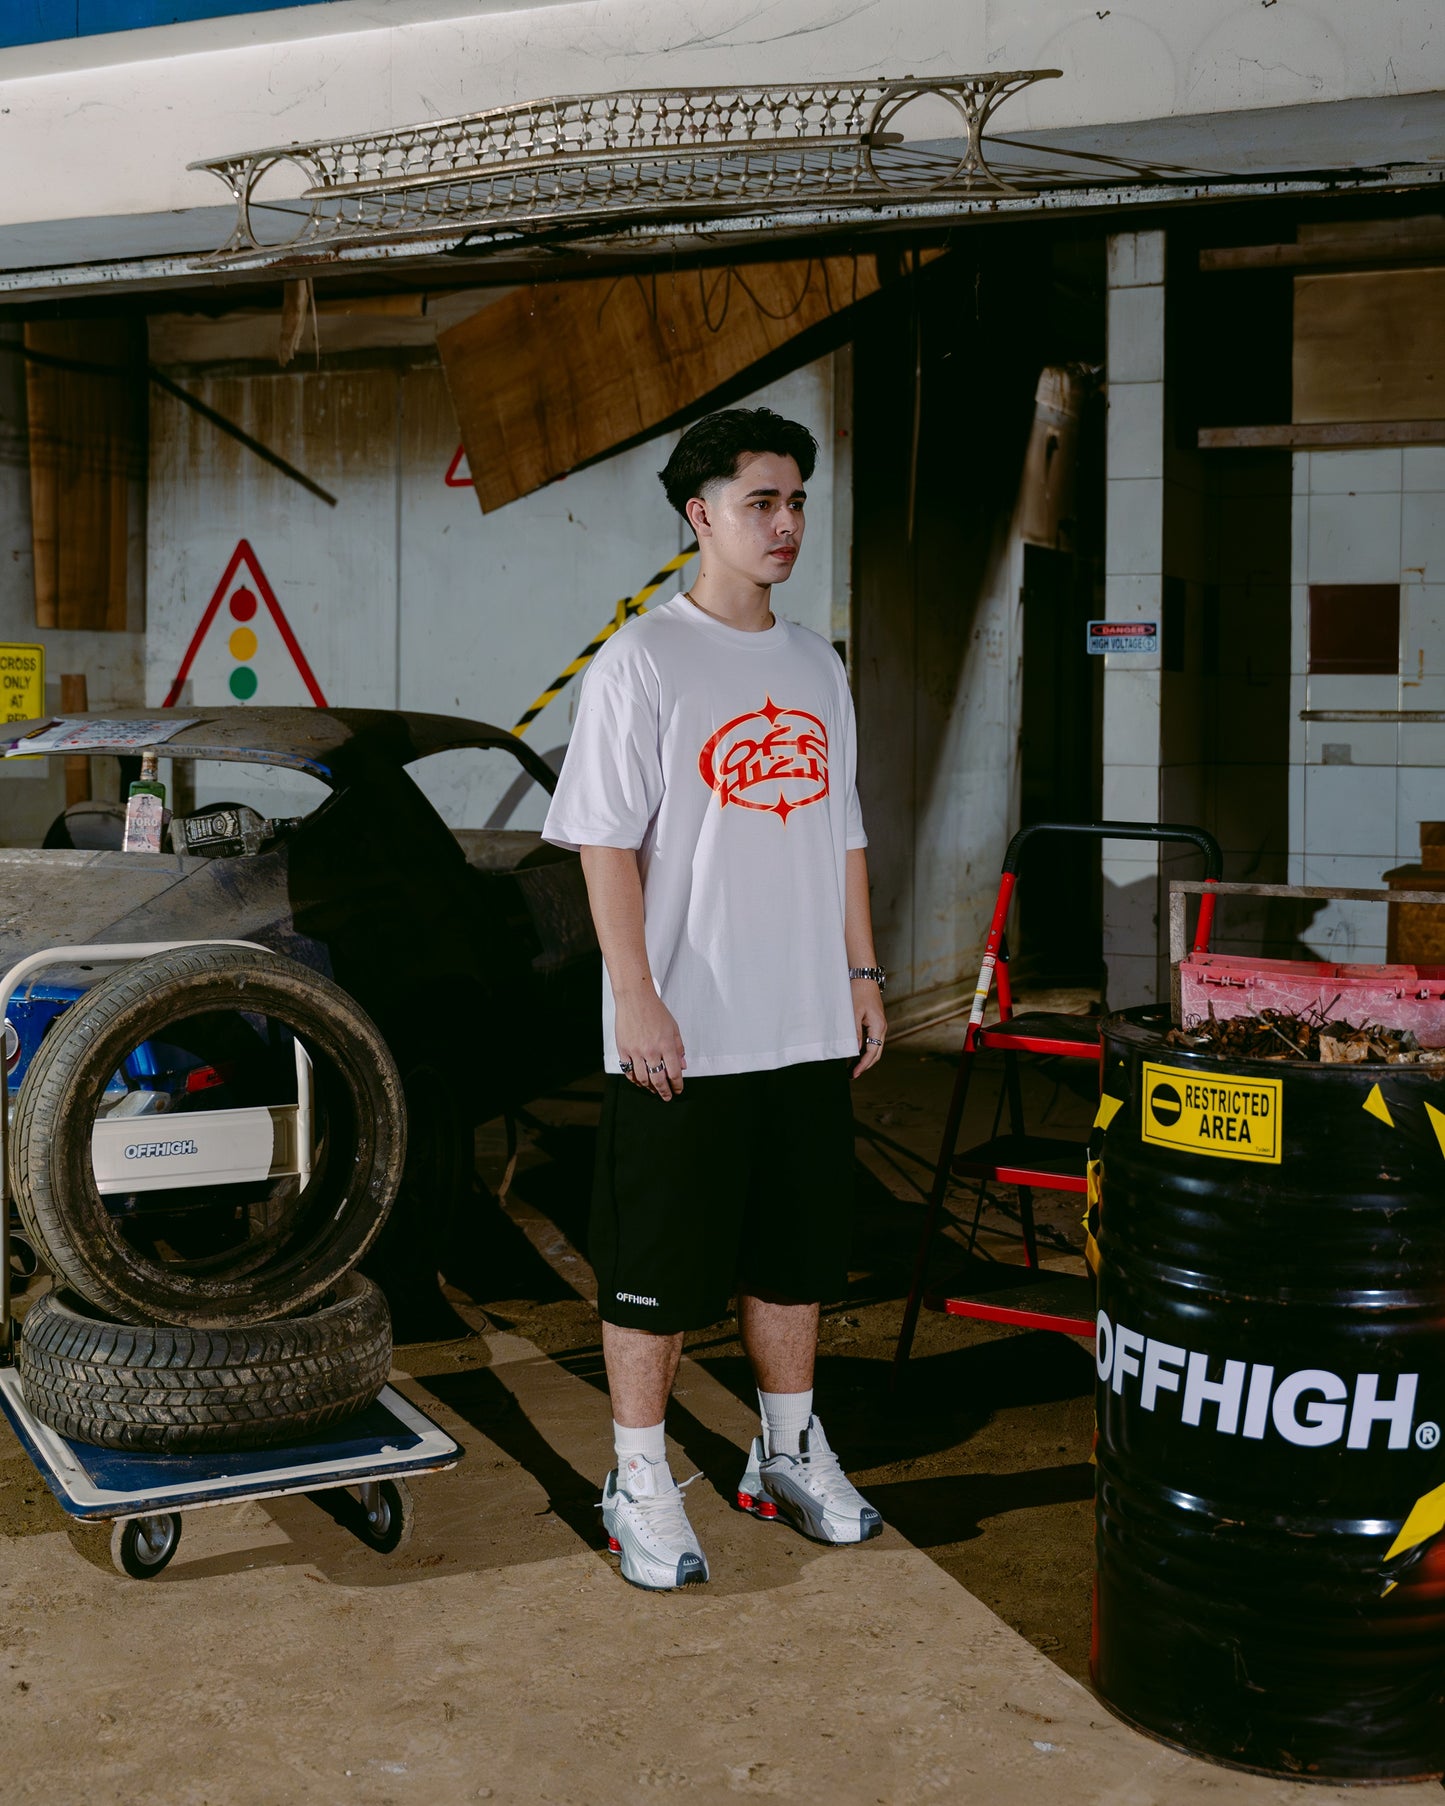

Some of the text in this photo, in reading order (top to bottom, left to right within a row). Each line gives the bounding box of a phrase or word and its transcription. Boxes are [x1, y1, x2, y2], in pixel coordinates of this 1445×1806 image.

[1101, 625, 1144, 634] DANGER
[1091, 638, 1142, 649] HIGH VOLTAGE
[0, 657, 37, 671] CROSS
[3, 675, 31, 689] ONLY
[10, 694, 24, 708] AT
[130, 817, 158, 826] TORO
[1185, 1084, 1269, 1118] RESTRICTED
[1199, 1114, 1252, 1144] AREA
